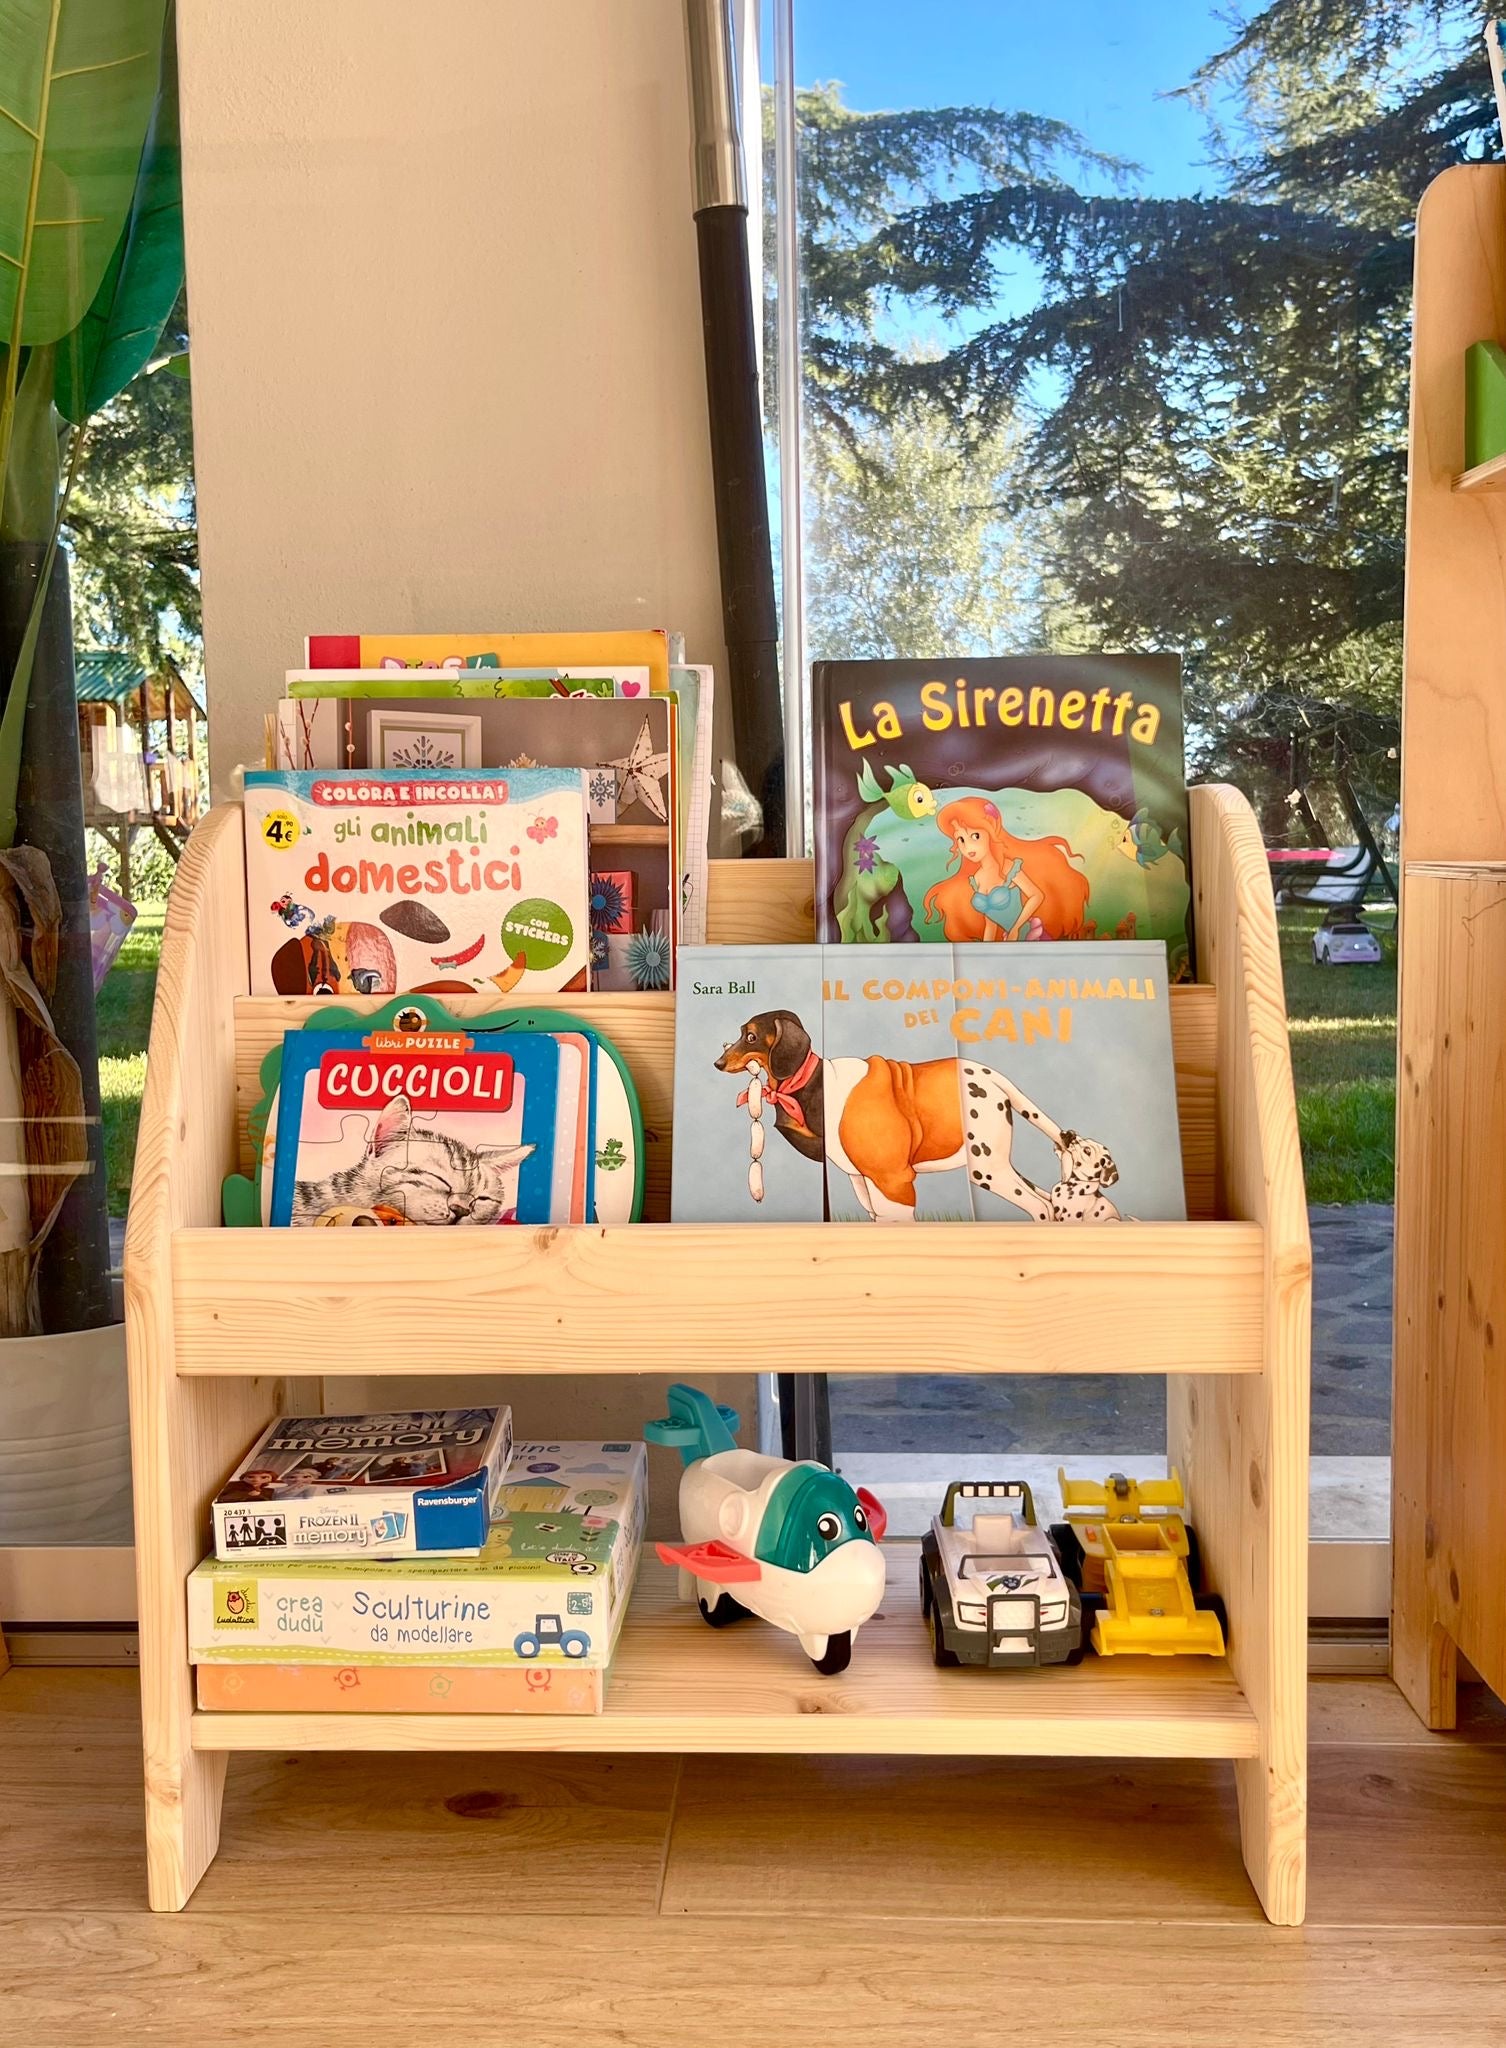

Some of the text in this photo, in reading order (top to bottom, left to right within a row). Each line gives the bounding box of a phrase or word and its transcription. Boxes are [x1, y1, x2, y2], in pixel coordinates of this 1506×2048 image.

[839, 678, 1161, 750] La Sirenetta
[321, 785, 504, 801] COLORA E INCOLLA!
[334, 811, 488, 846] gli animali
[304, 845, 522, 895] domestici
[505, 921, 569, 946] STICKERS
[530, 918, 550, 930] CON
[692, 980, 756, 995] Sara Ball
[822, 978, 1156, 1001] IL COMPONI-ANIMALI
[904, 1007, 1073, 1046] DEI CANI
[375, 1037, 461, 1050] libri PUZZLE
[326, 1062, 505, 1100] CUCCIOLI
[267, 1426, 485, 1450] memory
[321, 1422, 422, 1436] FROZEN
[417, 1496, 478, 1506] Ravensburger
[300, 1514, 359, 1528] FROZEN II
[294, 1529, 368, 1547] memory
[276, 1596, 323, 1613] crea
[353, 1591, 490, 1621] Sculturine
[216, 1616, 255, 1624] Ludattica
[277, 1613, 324, 1632] dudù
[370, 1624, 473, 1644] da modellare
